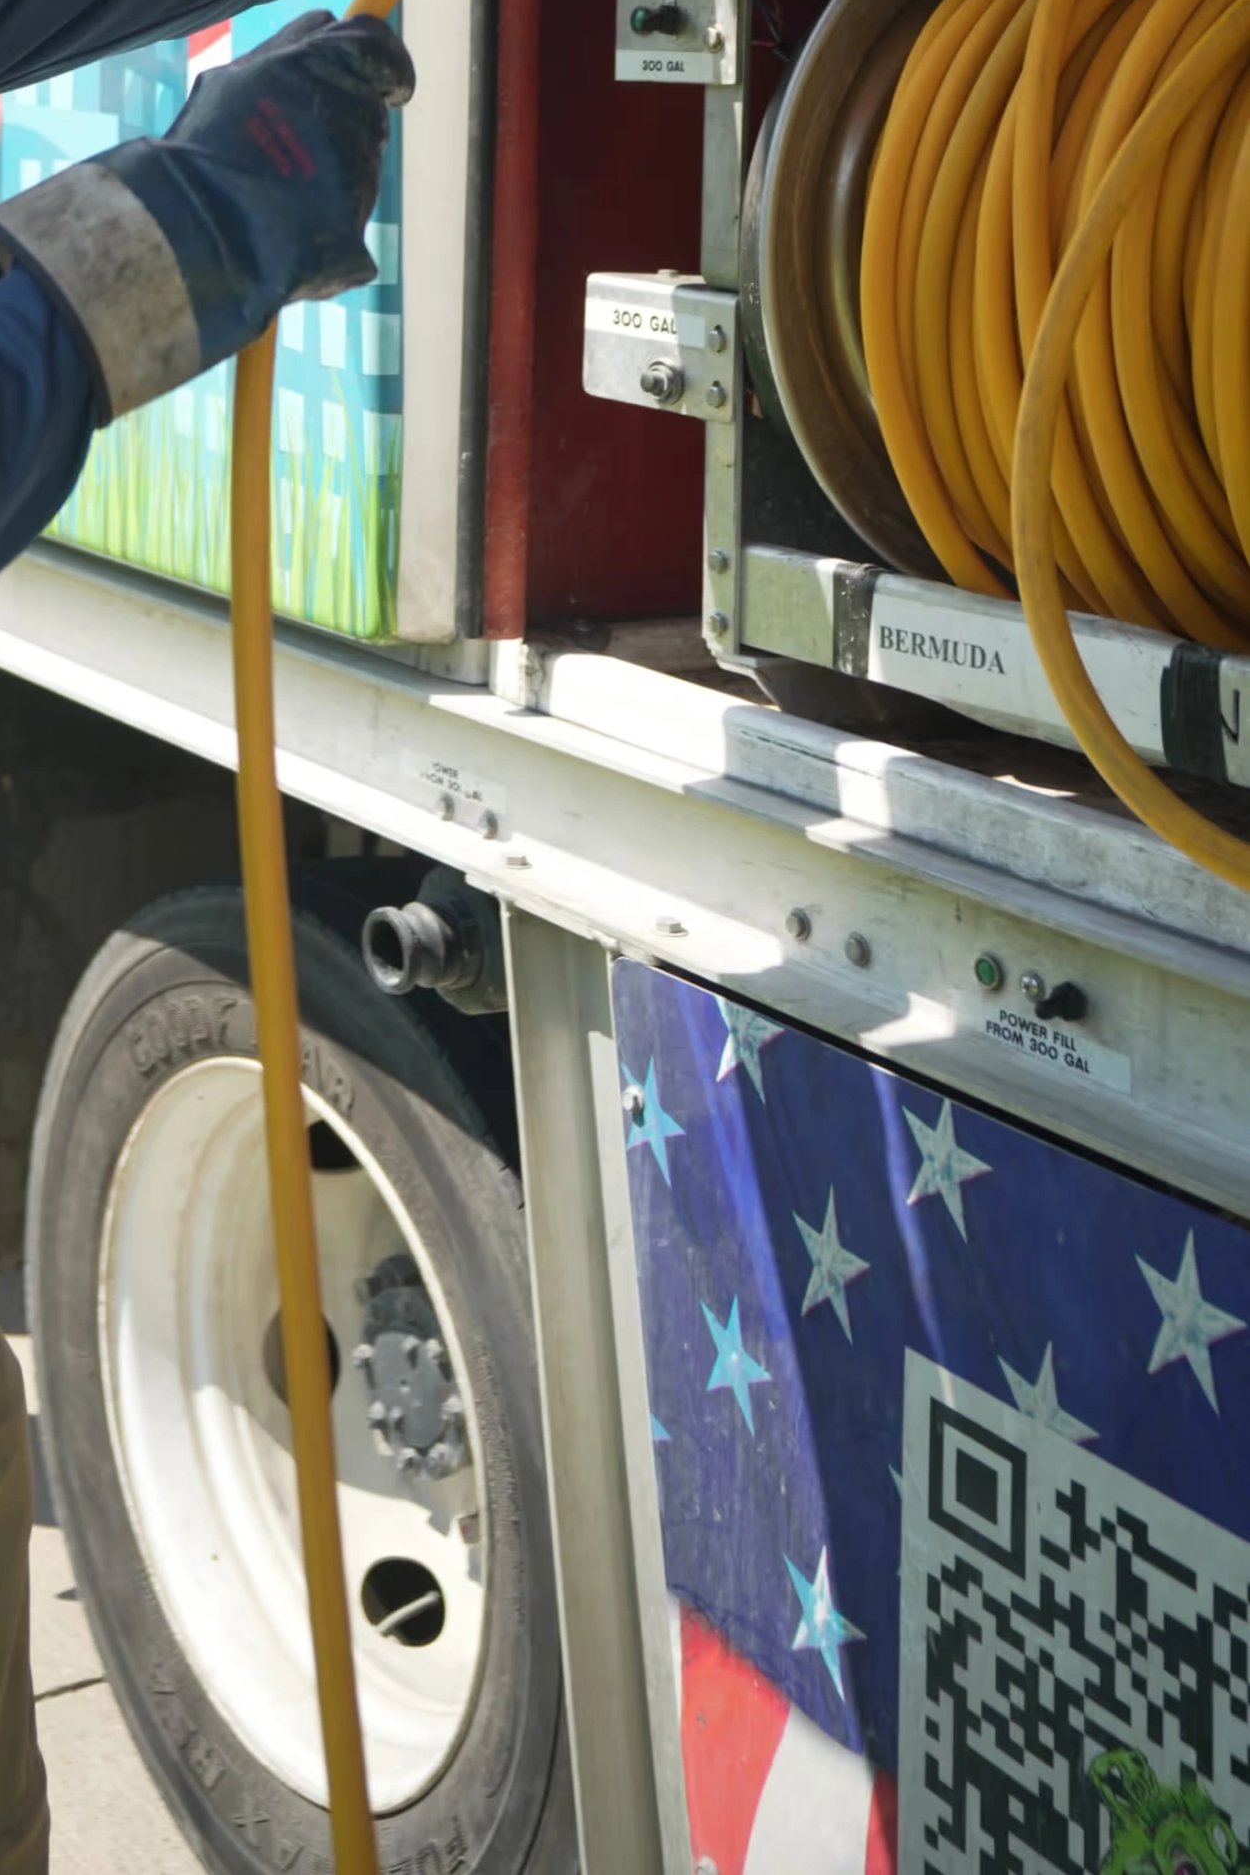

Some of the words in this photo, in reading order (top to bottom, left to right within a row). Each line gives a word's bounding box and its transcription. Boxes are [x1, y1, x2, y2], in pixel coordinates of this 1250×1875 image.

[642, 59, 663, 72] 300
[666, 60, 685, 73] GAL
[612, 308, 643, 329] 300
[650, 314, 677, 335] GAL
[879, 624, 1006, 675] BERMUDA
[986, 1020, 1024, 1047] FROM
[1029, 1037, 1059, 1060] 300
[1064, 1052, 1090, 1074] GAL
[999, 1009, 1047, 1039] POWER
[1053, 1031, 1077, 1052] FILL
